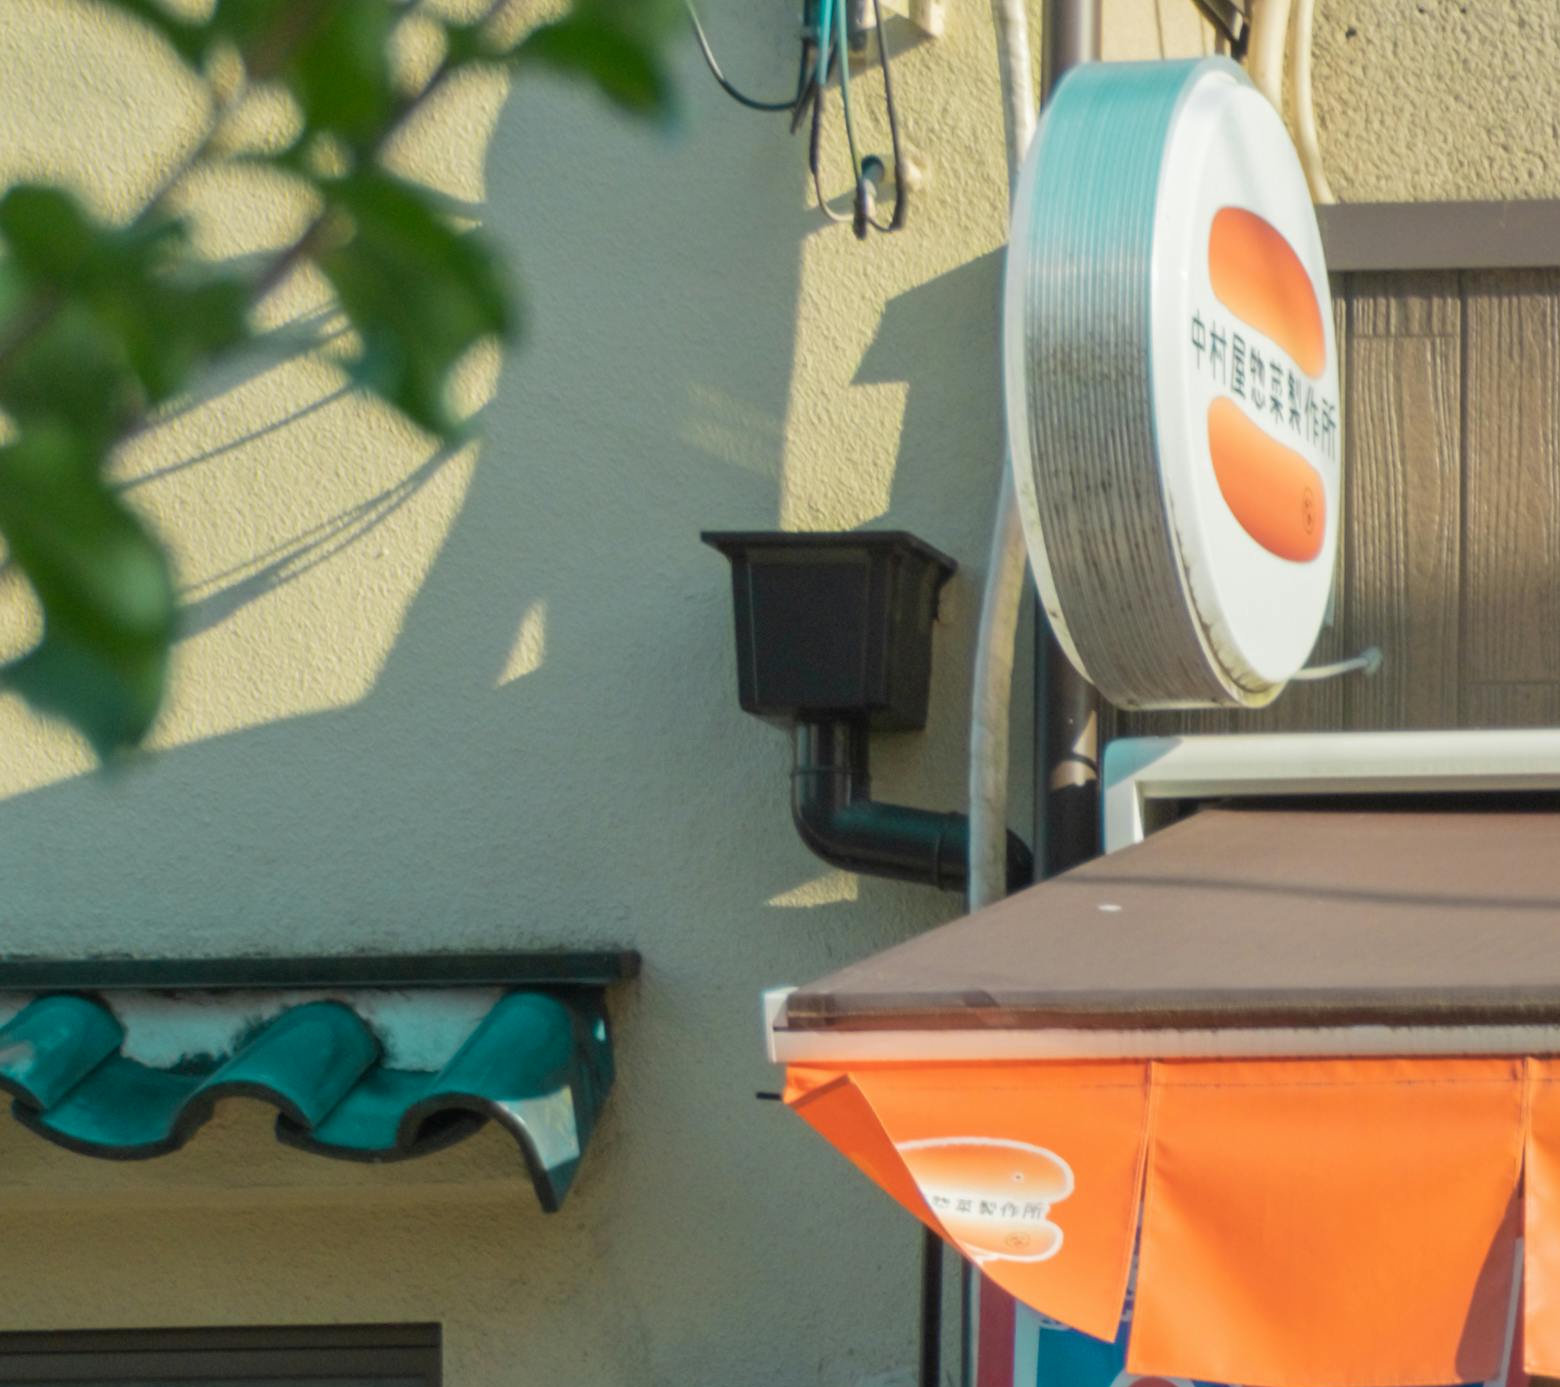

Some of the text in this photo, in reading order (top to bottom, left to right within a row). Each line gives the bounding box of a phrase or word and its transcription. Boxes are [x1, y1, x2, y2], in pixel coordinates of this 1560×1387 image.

[1189, 310, 1338, 462] 中村屋惣菜製作所
